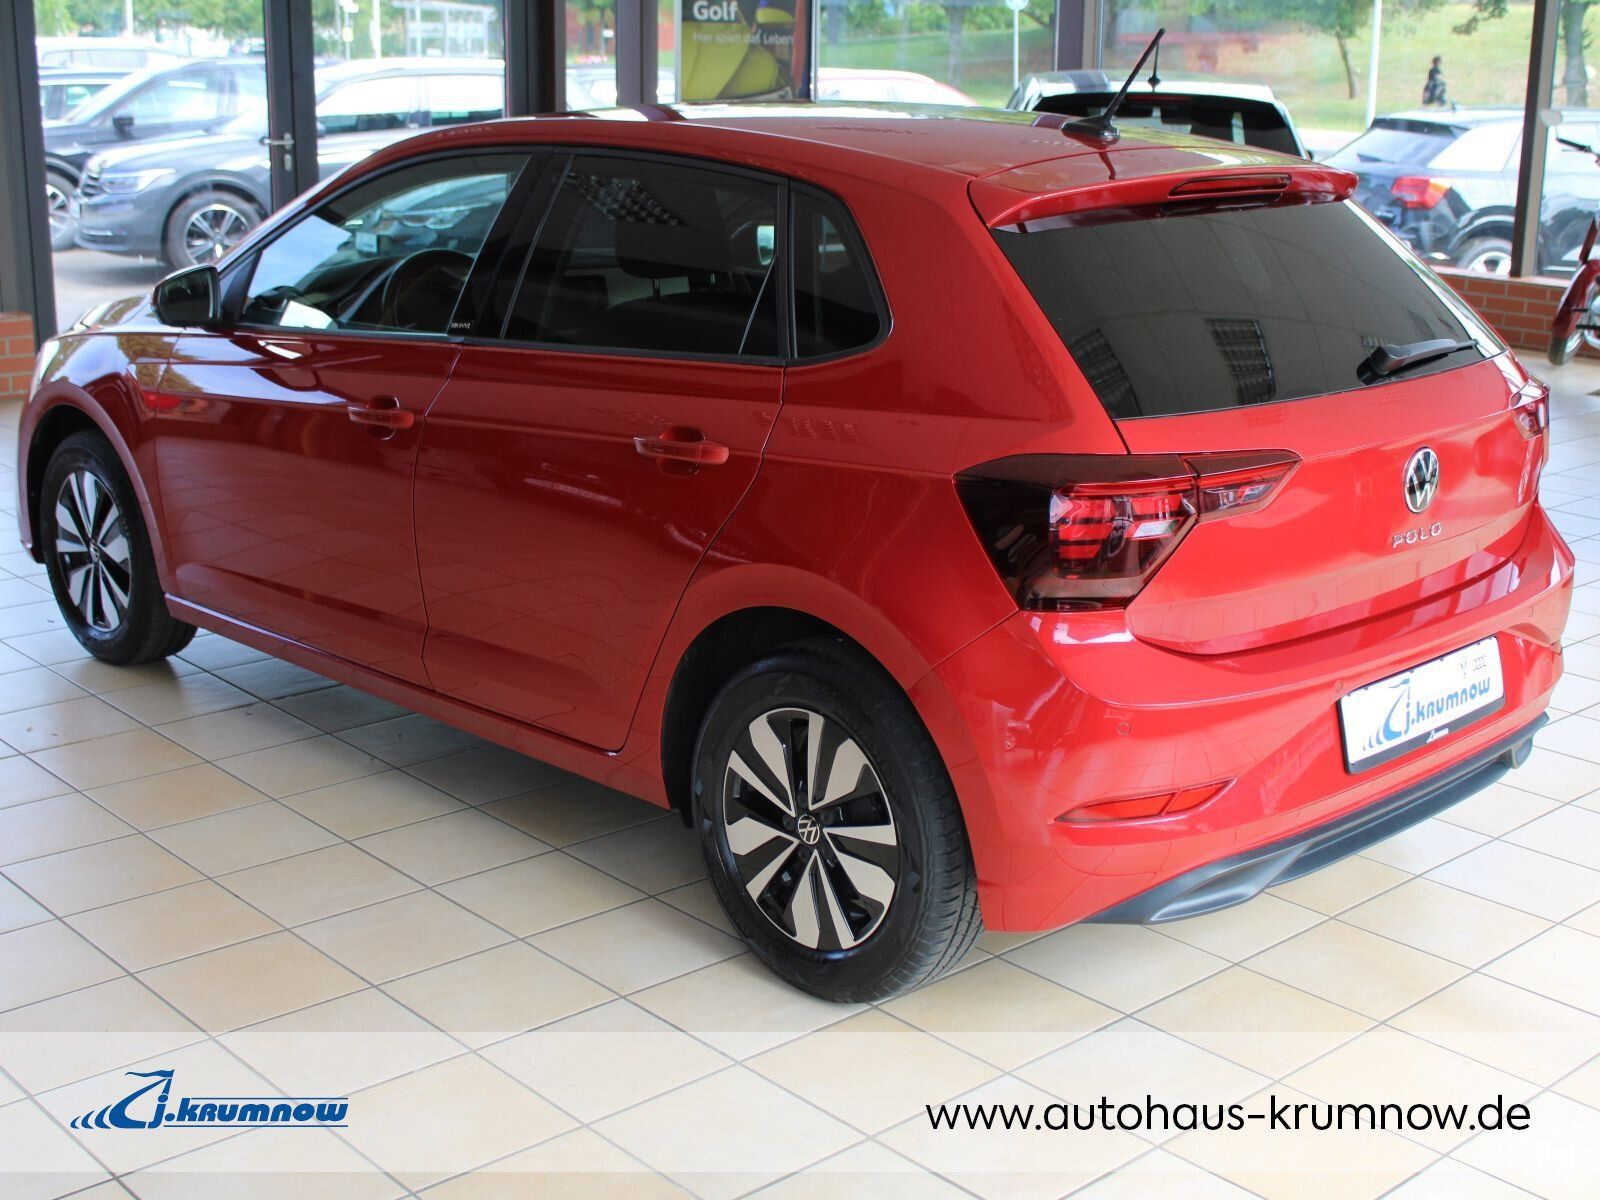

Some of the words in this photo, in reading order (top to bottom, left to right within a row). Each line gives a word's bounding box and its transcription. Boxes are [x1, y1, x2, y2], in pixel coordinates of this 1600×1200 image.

[692, 0, 738, 21] Golf
[692, 32, 713, 43] Hier
[1391, 522, 1442, 549] POLO
